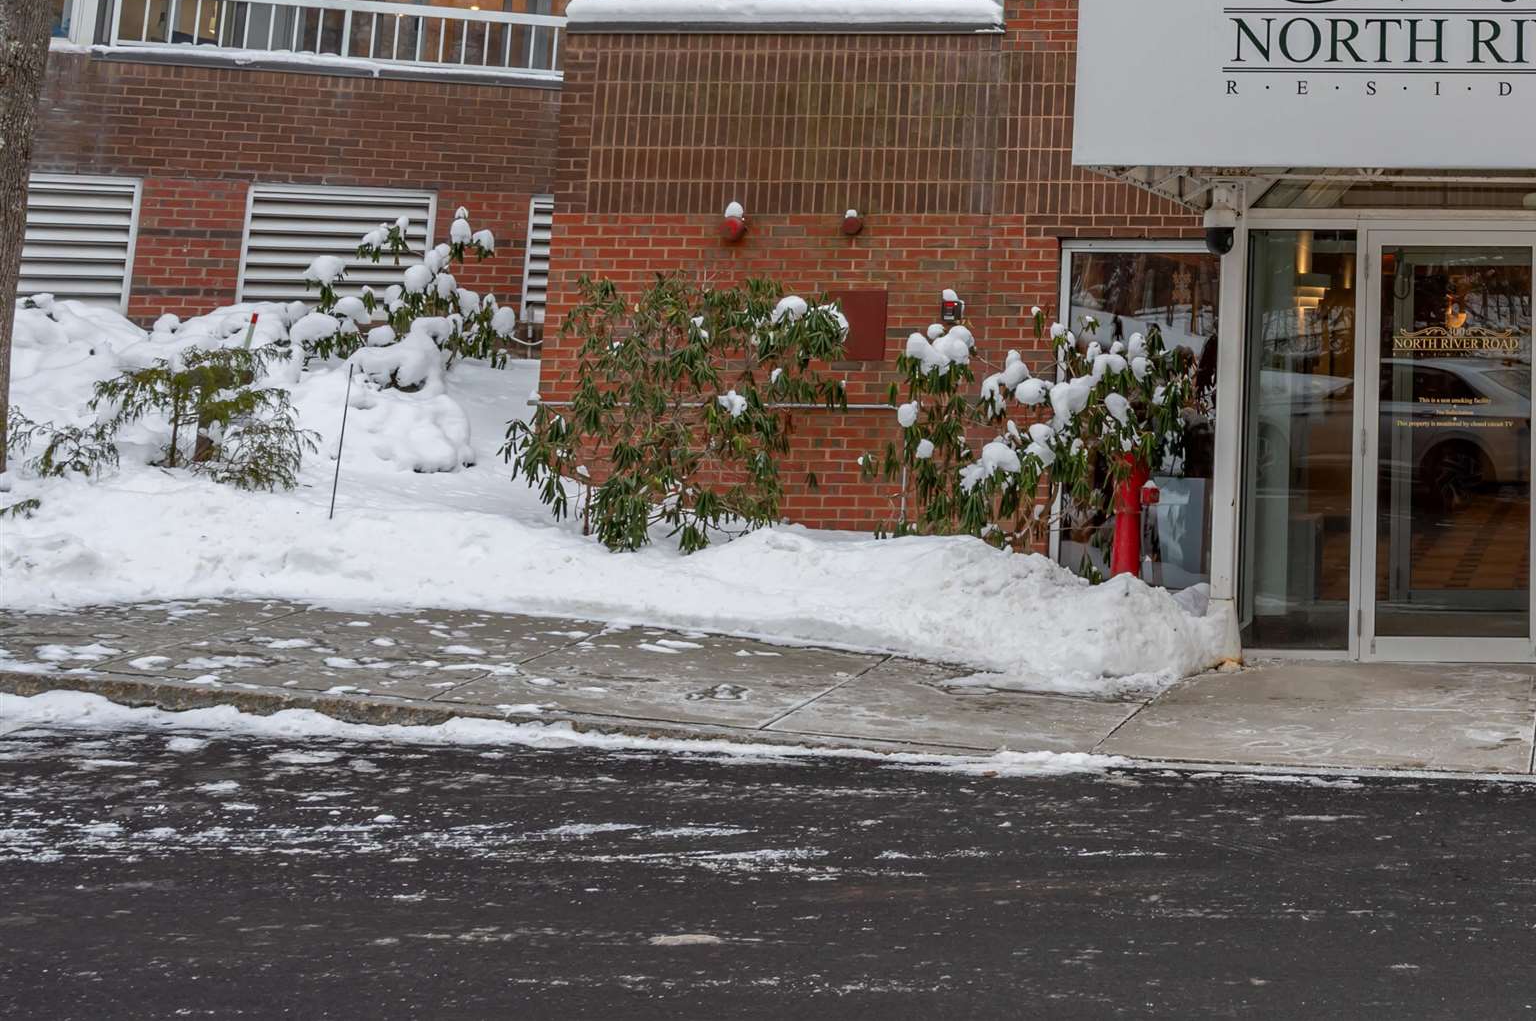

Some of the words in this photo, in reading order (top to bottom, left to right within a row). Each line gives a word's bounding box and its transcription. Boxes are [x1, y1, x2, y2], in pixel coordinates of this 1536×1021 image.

[1229, 17, 1449, 64] NORTH
[1393, 338, 1438, 350] NORTH
[1441, 338, 1479, 350] RIVER
[1482, 338, 1519, 350] ROAD
